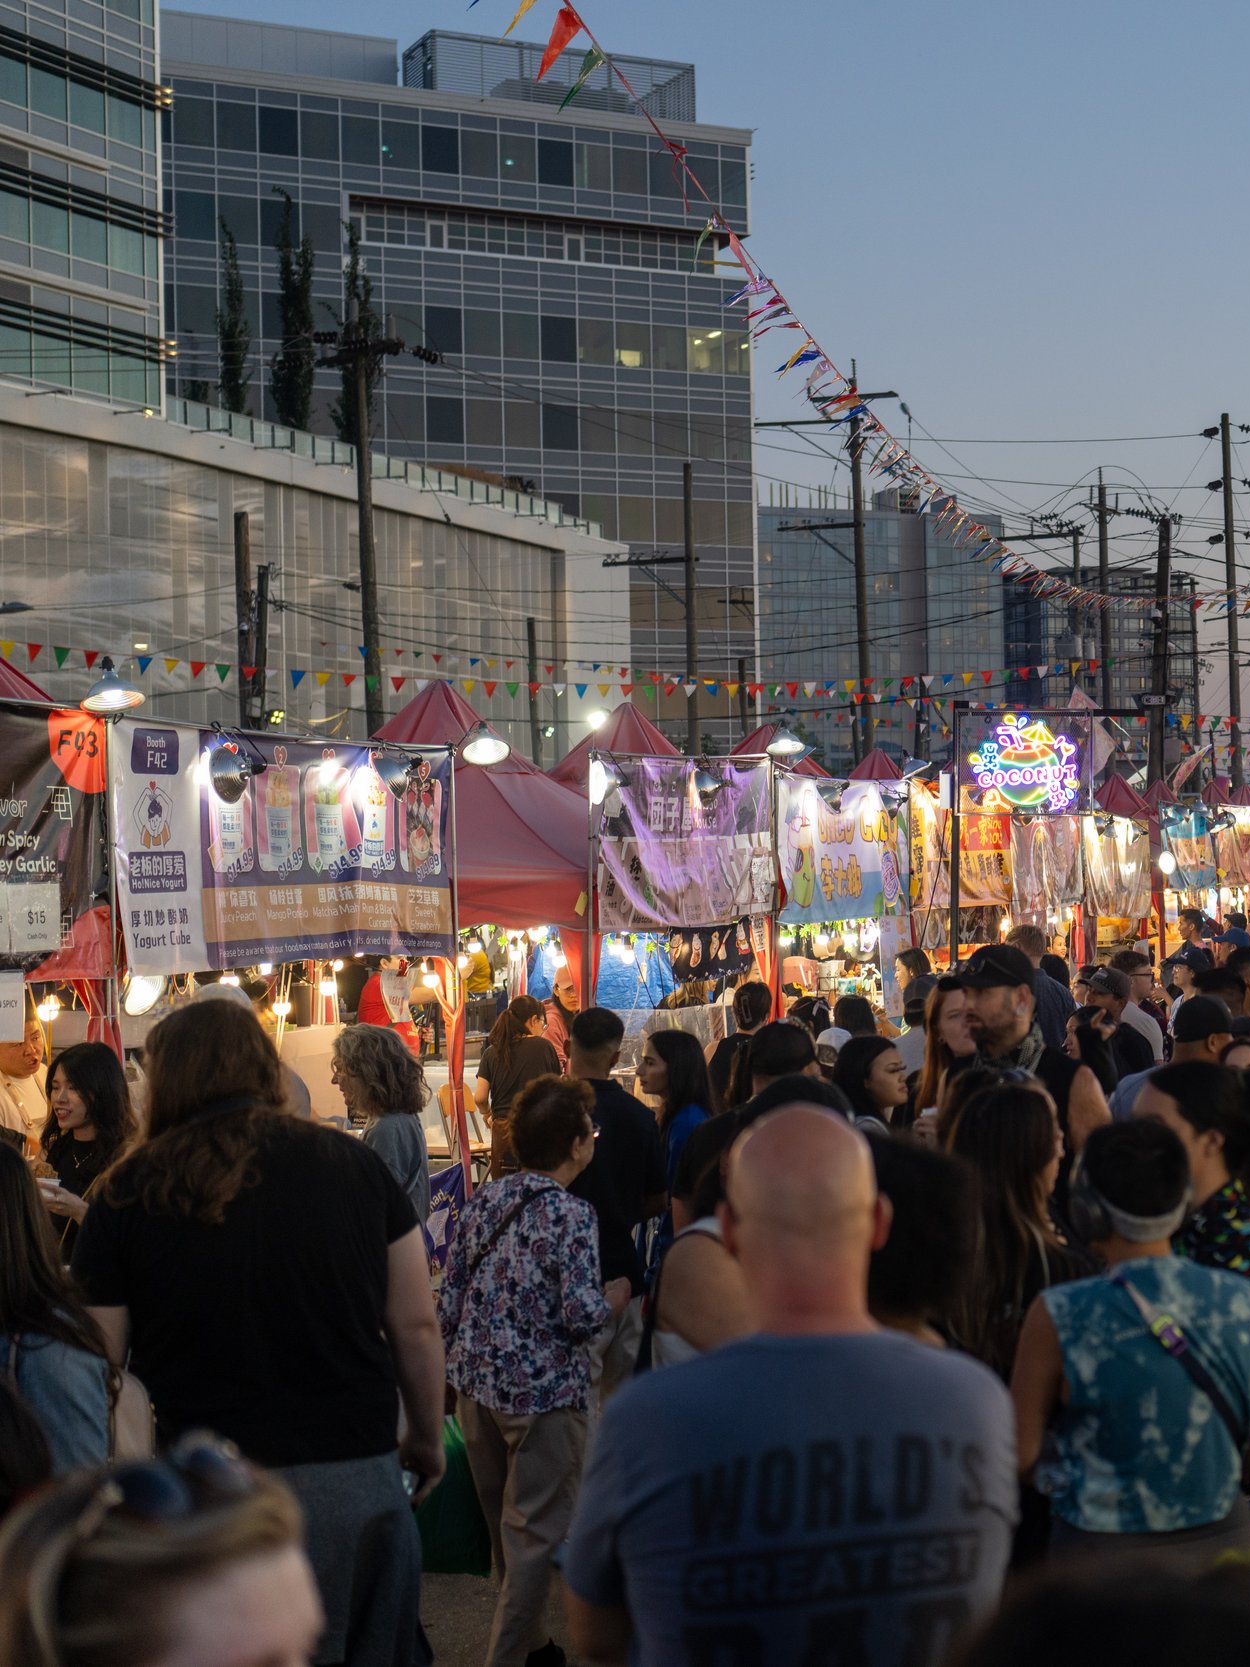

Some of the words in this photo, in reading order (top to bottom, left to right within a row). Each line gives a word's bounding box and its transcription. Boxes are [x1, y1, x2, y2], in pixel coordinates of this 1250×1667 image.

[146, 735, 166, 748] Booth
[147, 750, 167, 768] F42
[978, 764, 1077, 788] COCONUT
[7, 829, 40, 851] Spicy
[15, 856, 56, 873] Garlic
[130, 855, 185, 877] 老板的厚爱
[227, 847, 253, 882] $14.99
[278, 846, 304, 880] $14.99
[371, 848, 397, 878] $14.99
[415, 853, 440, 882] $14.99
[161, 878, 185, 890] Yogurt
[27, 910, 46, 925] $15
[236, 910, 257, 922] Peach
[312, 905, 338, 918] Matcha
[39, 933, 48, 941] Only
[133, 933, 167, 949] Yogurt
[170, 930, 191, 945] Cube
[246, 947, 264, 956] aware
[285, 943, 299, 952] food
[3, 1000, 17, 1008] SPICY
[689, 1433, 985, 1545] WORLD'S
[690, 1538, 980, 1605] GREATEST
